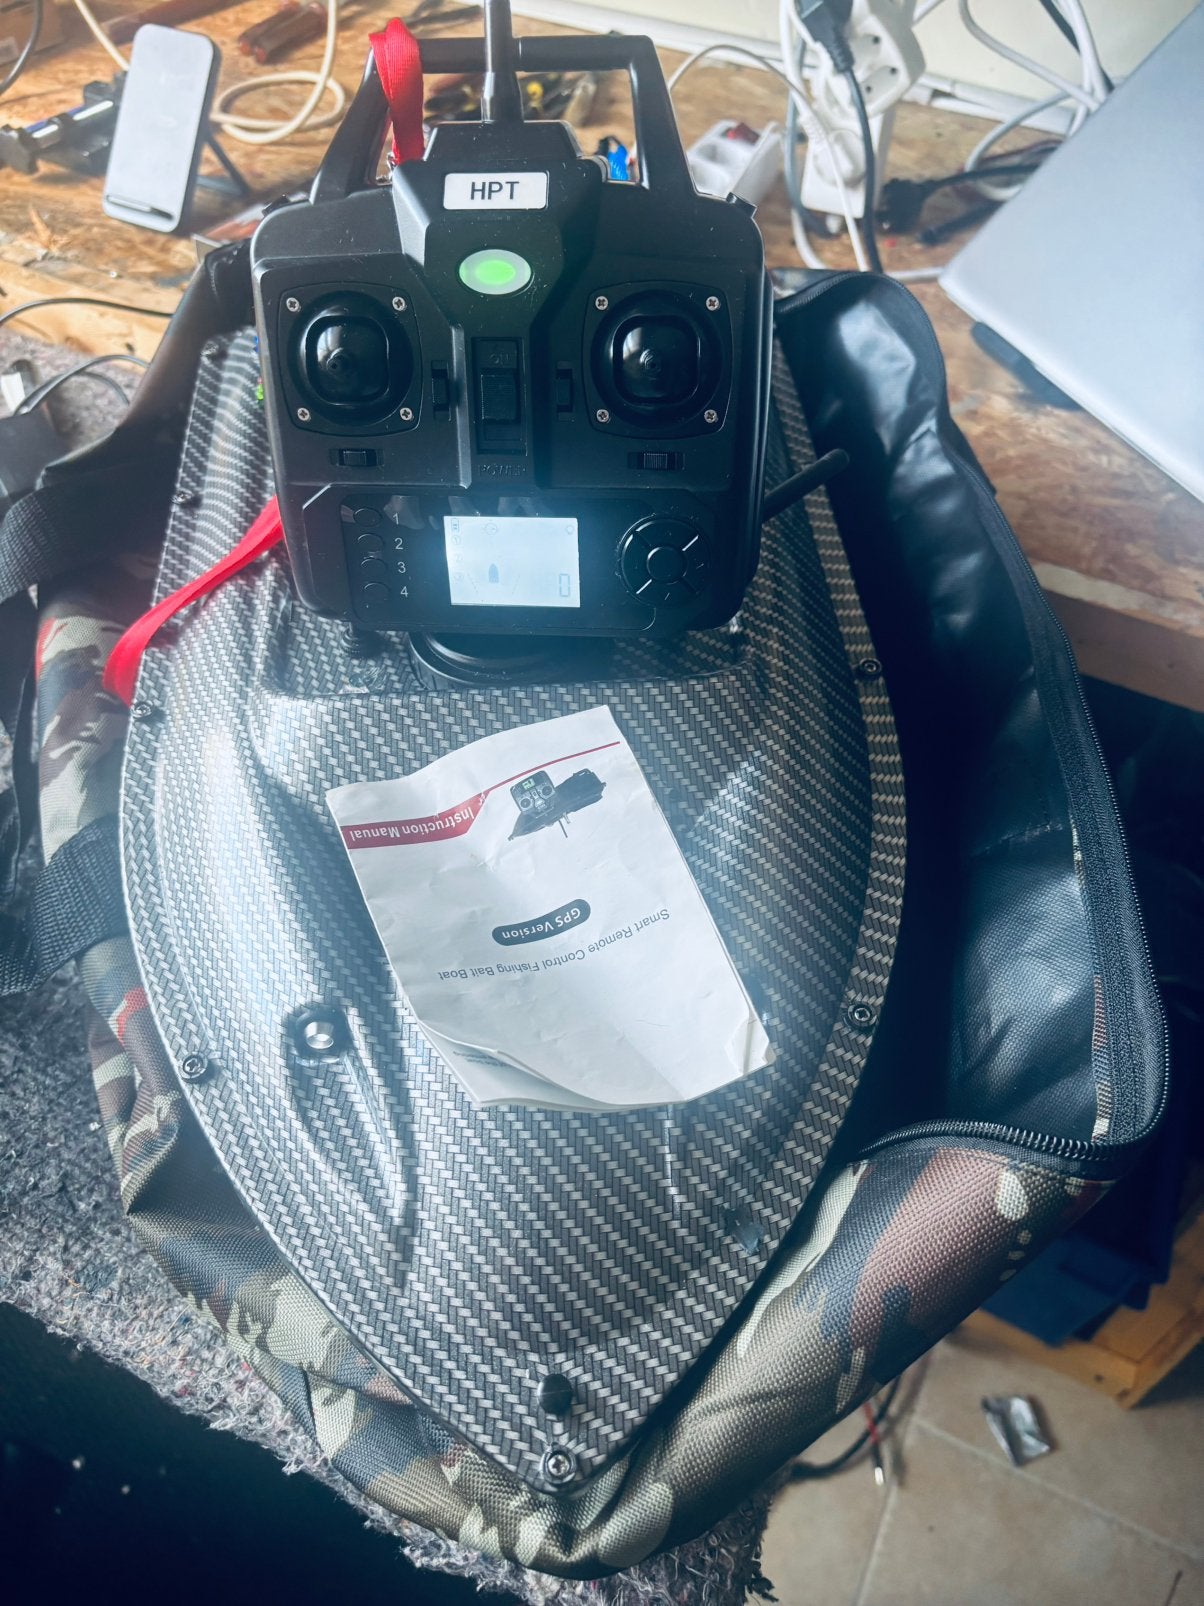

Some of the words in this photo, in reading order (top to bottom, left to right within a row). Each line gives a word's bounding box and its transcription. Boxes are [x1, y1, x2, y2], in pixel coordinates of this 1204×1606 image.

[470, 181, 520, 200] HPT
[392, 513, 400, 525] 1
[394, 537, 404, 550] 2
[397, 562, 406, 574] 3
[399, 585, 409, 598] 4
[402, 806, 475, 836] Instruction
[349, 826, 401, 842] Manual
[555, 907, 581, 928] GPS
[636, 908, 671, 933] Smart
[501, 921, 555, 940] Version
[588, 926, 634, 953] Remote
[542, 949, 586, 968] Control
[437, 968, 468, 981] Boat
[470, 966, 496, 978] Bait
[496, 961, 540, 974] Fishing
